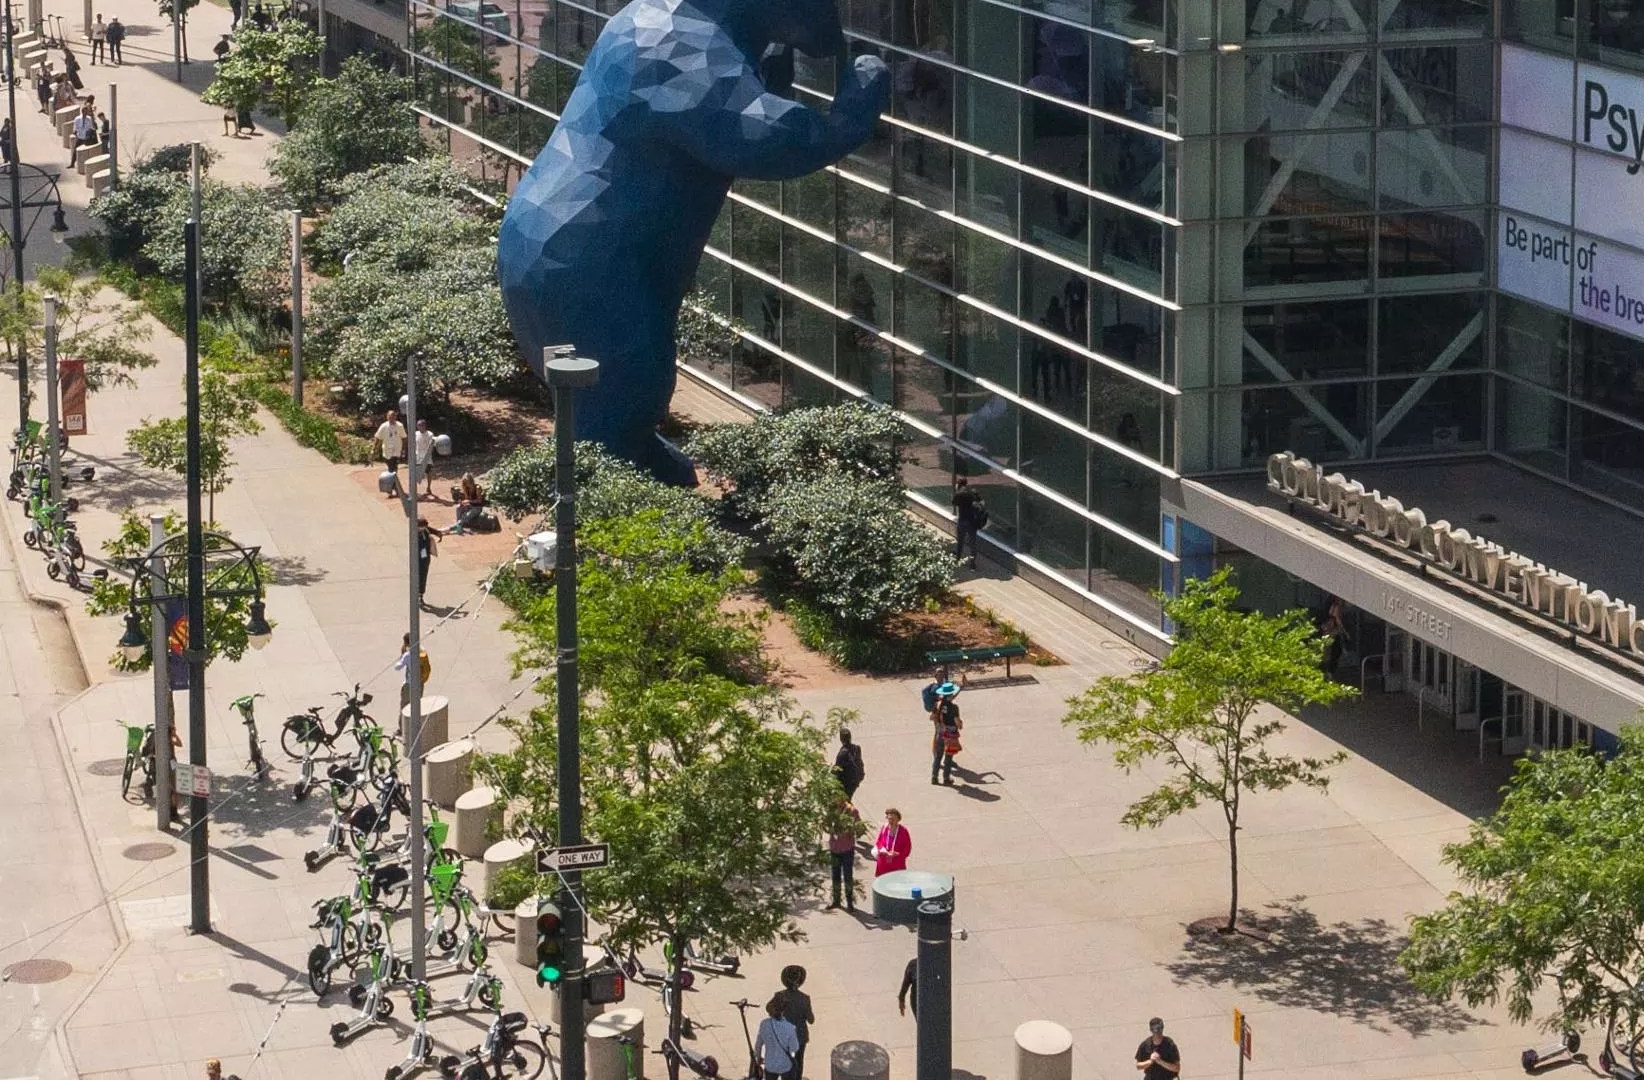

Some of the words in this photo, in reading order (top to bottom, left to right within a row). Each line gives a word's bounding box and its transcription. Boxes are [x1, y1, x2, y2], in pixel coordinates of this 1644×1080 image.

[1505, 217, 1528, 252] Be
[1531, 232, 1570, 265] part
[1577, 242, 1598, 271] of
[1579, 276, 1611, 313] the
[1267, 450, 1423, 548] COLORADO
[1421, 520, 1633, 648] CONVENTION
[1407, 604, 1452, 640] STREET
[558, 854, 578, 865] ONE
[581, 852, 600, 862] WAY
